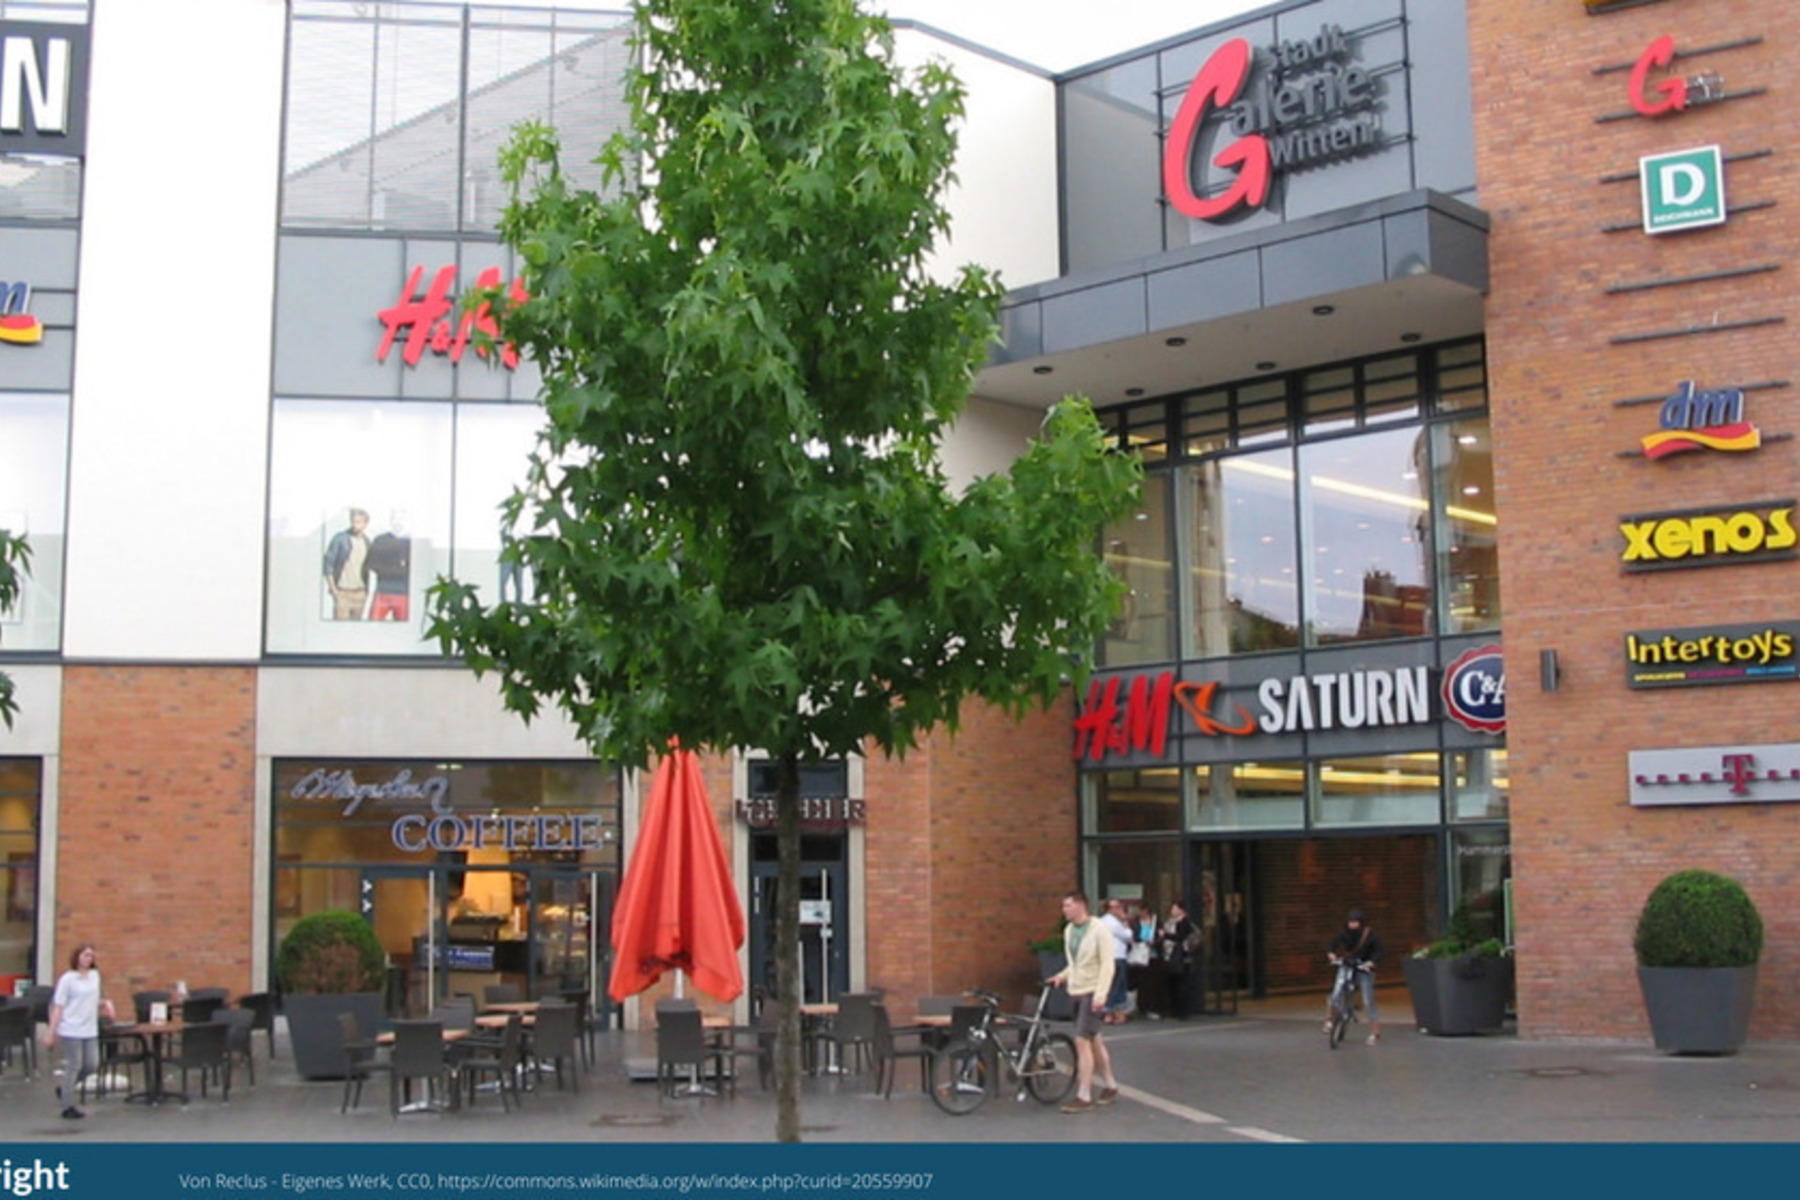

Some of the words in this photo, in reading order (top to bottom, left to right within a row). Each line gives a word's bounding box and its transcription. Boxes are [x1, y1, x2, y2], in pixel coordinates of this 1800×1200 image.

[1267, 23, 1350, 70] Stadt
[1660, 162, 1706, 206] D
[1660, 380, 1744, 431] dm
[1619, 508, 1797, 561] xenos
[1627, 629, 1793, 664] Intertoys
[1073, 671, 1175, 761] H&M
[1258, 666, 1430, 733] SATURN
[391, 814, 603, 852] COFFEE
